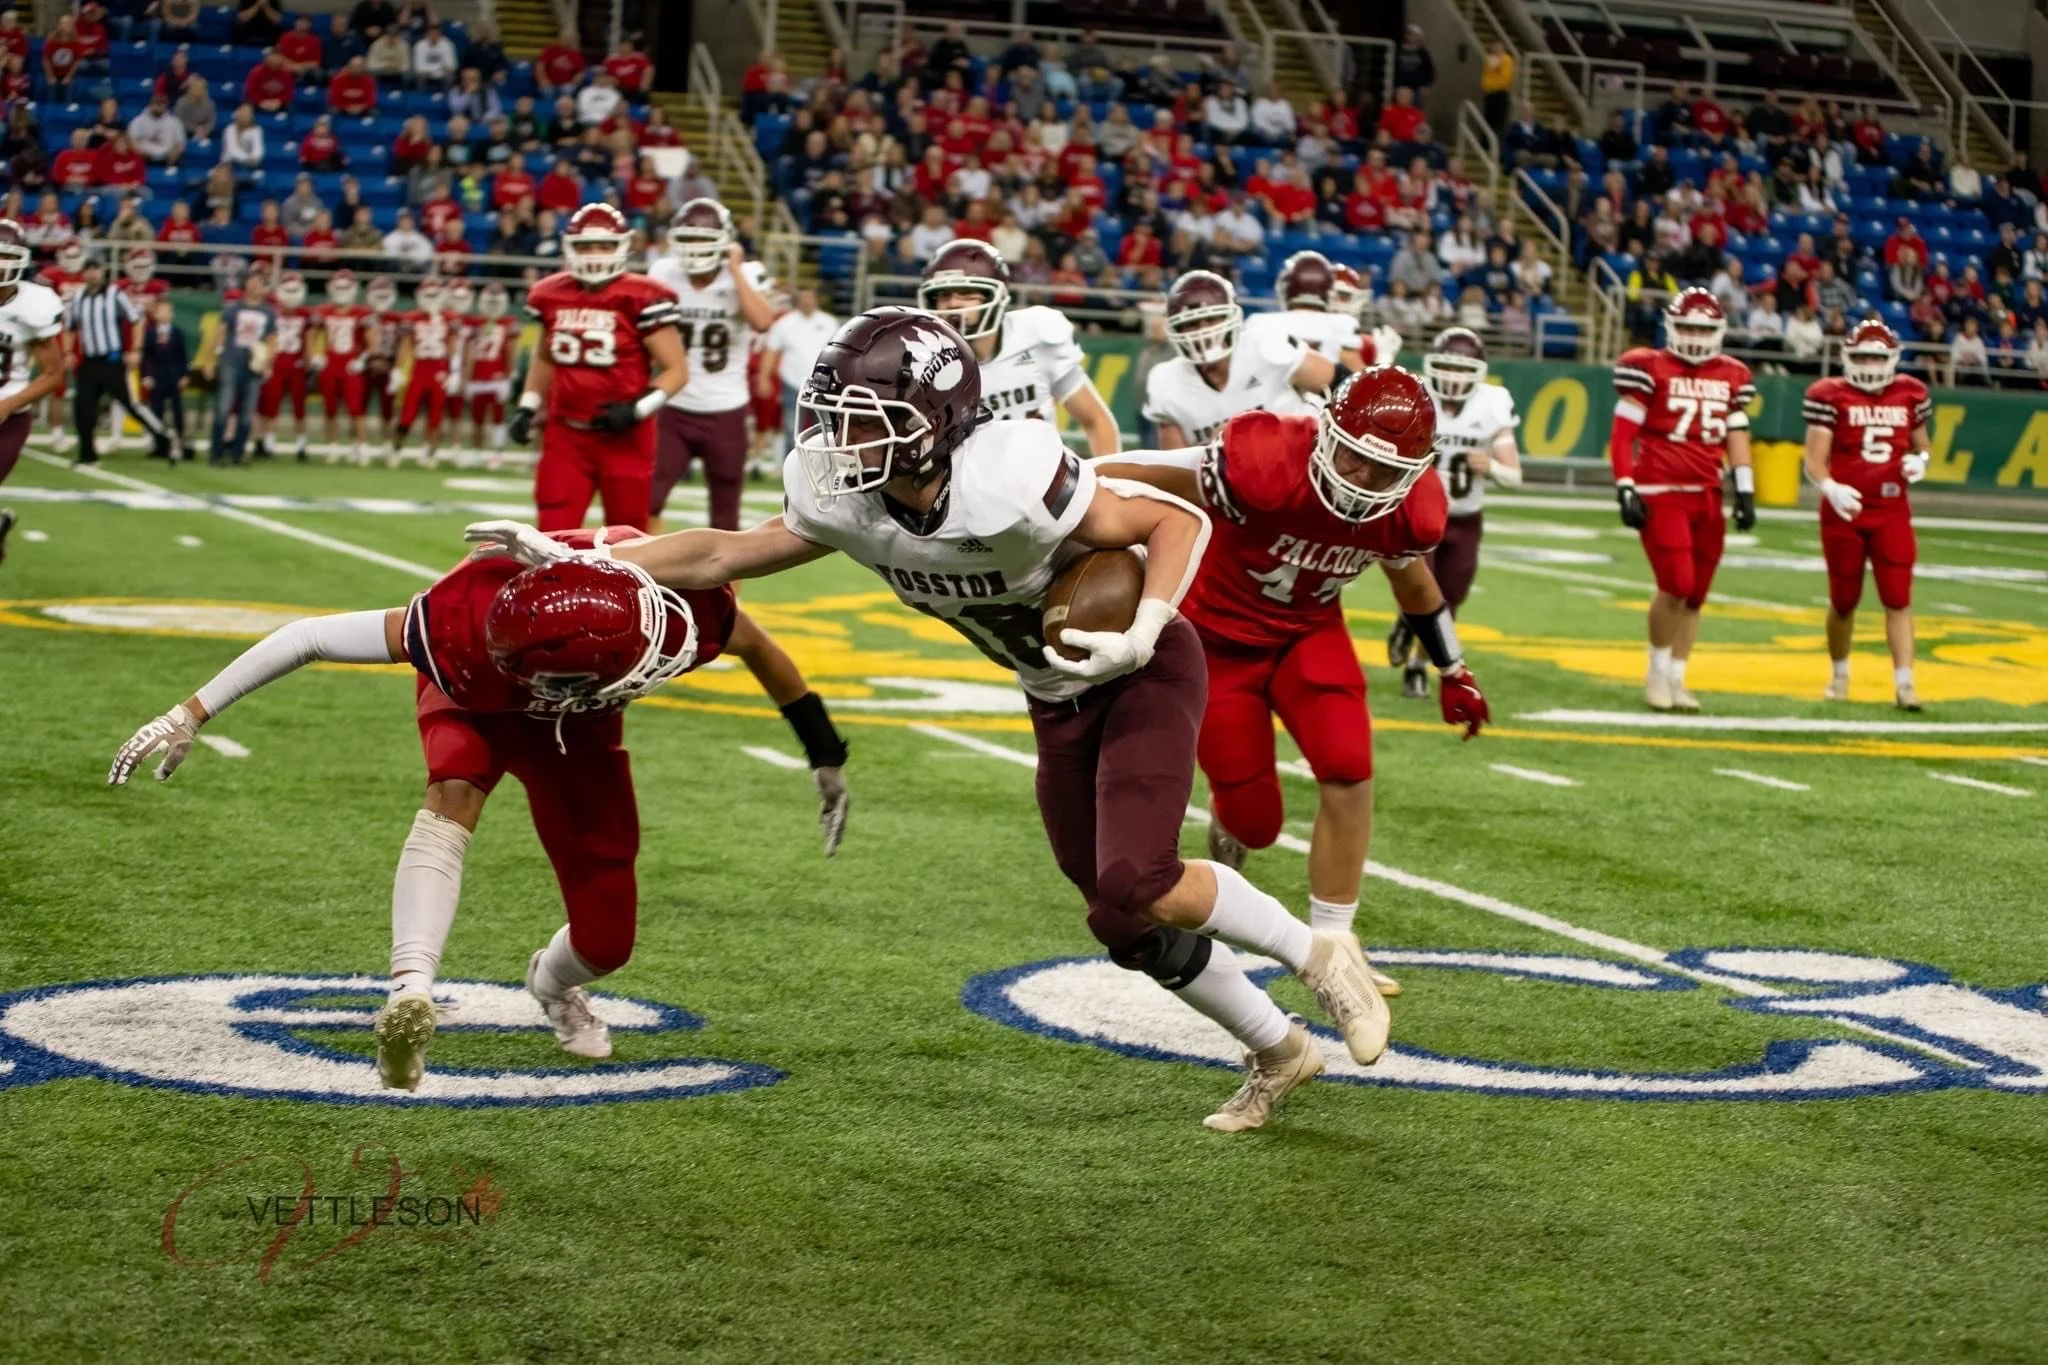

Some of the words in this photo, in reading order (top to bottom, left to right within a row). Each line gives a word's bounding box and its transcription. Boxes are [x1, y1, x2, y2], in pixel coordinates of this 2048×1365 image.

[552, 309, 617, 331] FALCONS
[980, 385, 1035, 411] STON
[1669, 377, 1730, 401] FALCONS
[1668, 398, 1728, 443] 75
[1849, 405, 1908, 427] FALCONS
[1861, 426, 1895, 464] 5
